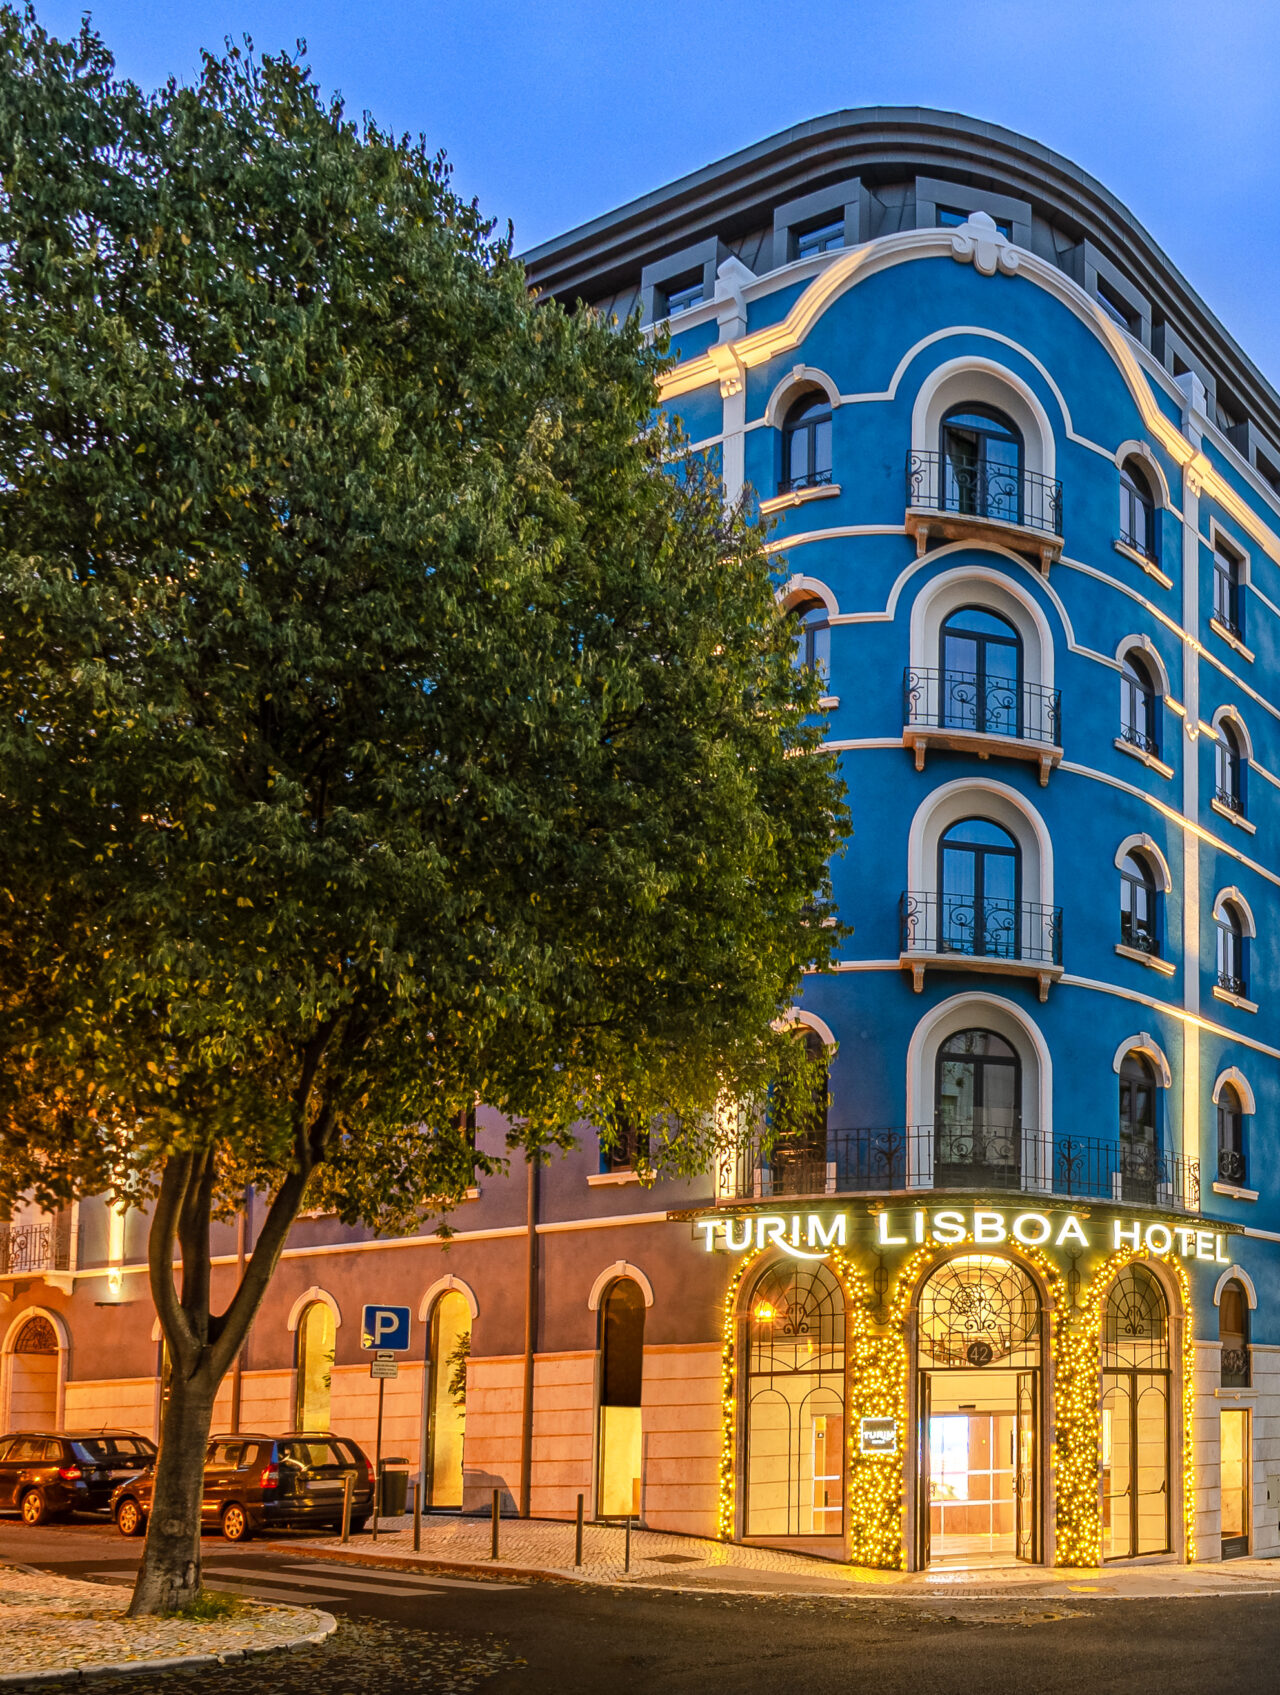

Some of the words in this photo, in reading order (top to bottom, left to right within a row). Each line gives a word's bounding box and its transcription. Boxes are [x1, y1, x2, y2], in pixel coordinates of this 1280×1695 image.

[698, 1214, 847, 1259] TURIM
[879, 1211, 1090, 1247] LISBOA
[1113, 1220, 1230, 1263] HOTEL
[374, 1311, 400, 1345] P
[970, 1346, 988, 1361] 42
